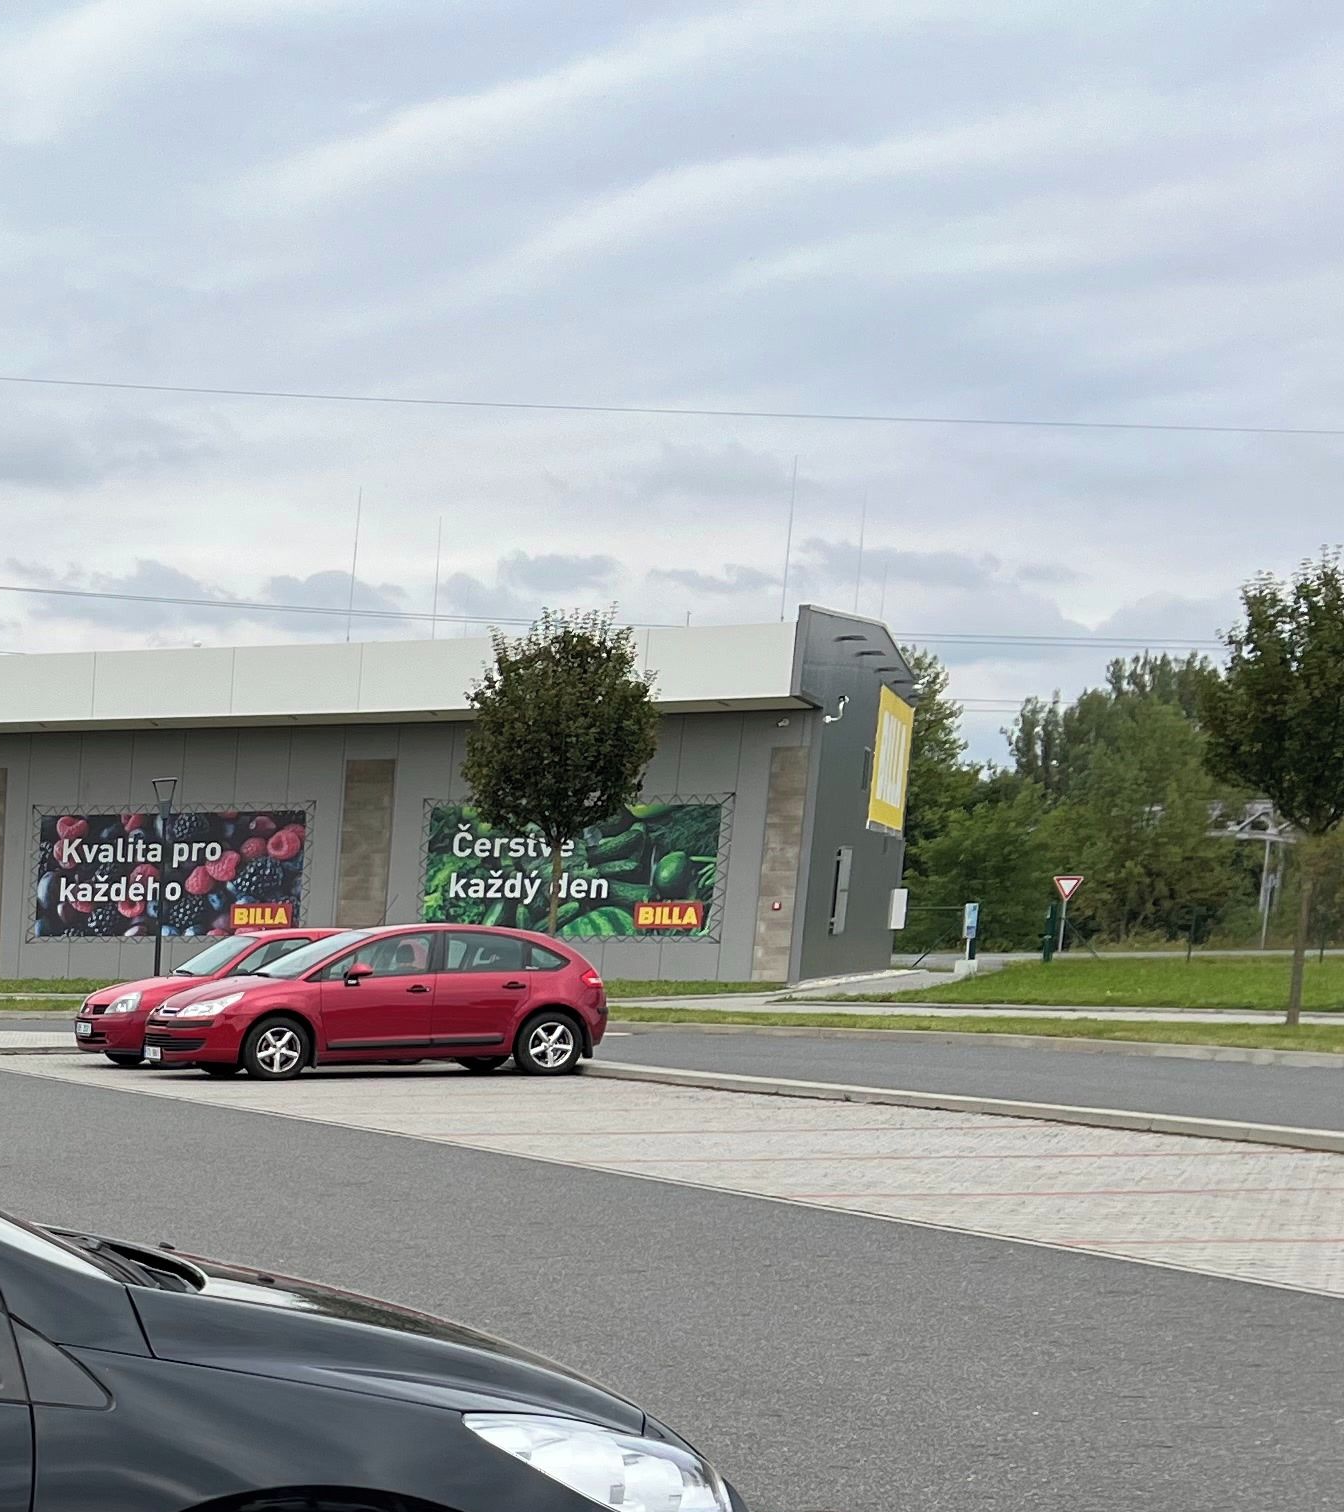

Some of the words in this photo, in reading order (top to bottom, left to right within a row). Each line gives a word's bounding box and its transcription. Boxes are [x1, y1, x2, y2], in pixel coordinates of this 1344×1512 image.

[62, 837, 162, 864] Kvalita
[172, 839, 222, 868] pro
[59, 874, 182, 902] každého
[448, 869, 542, 905] každý
[550, 871, 609, 899] den
[233, 907, 288, 925] BILLA
[637, 906, 698, 926] BILLA
